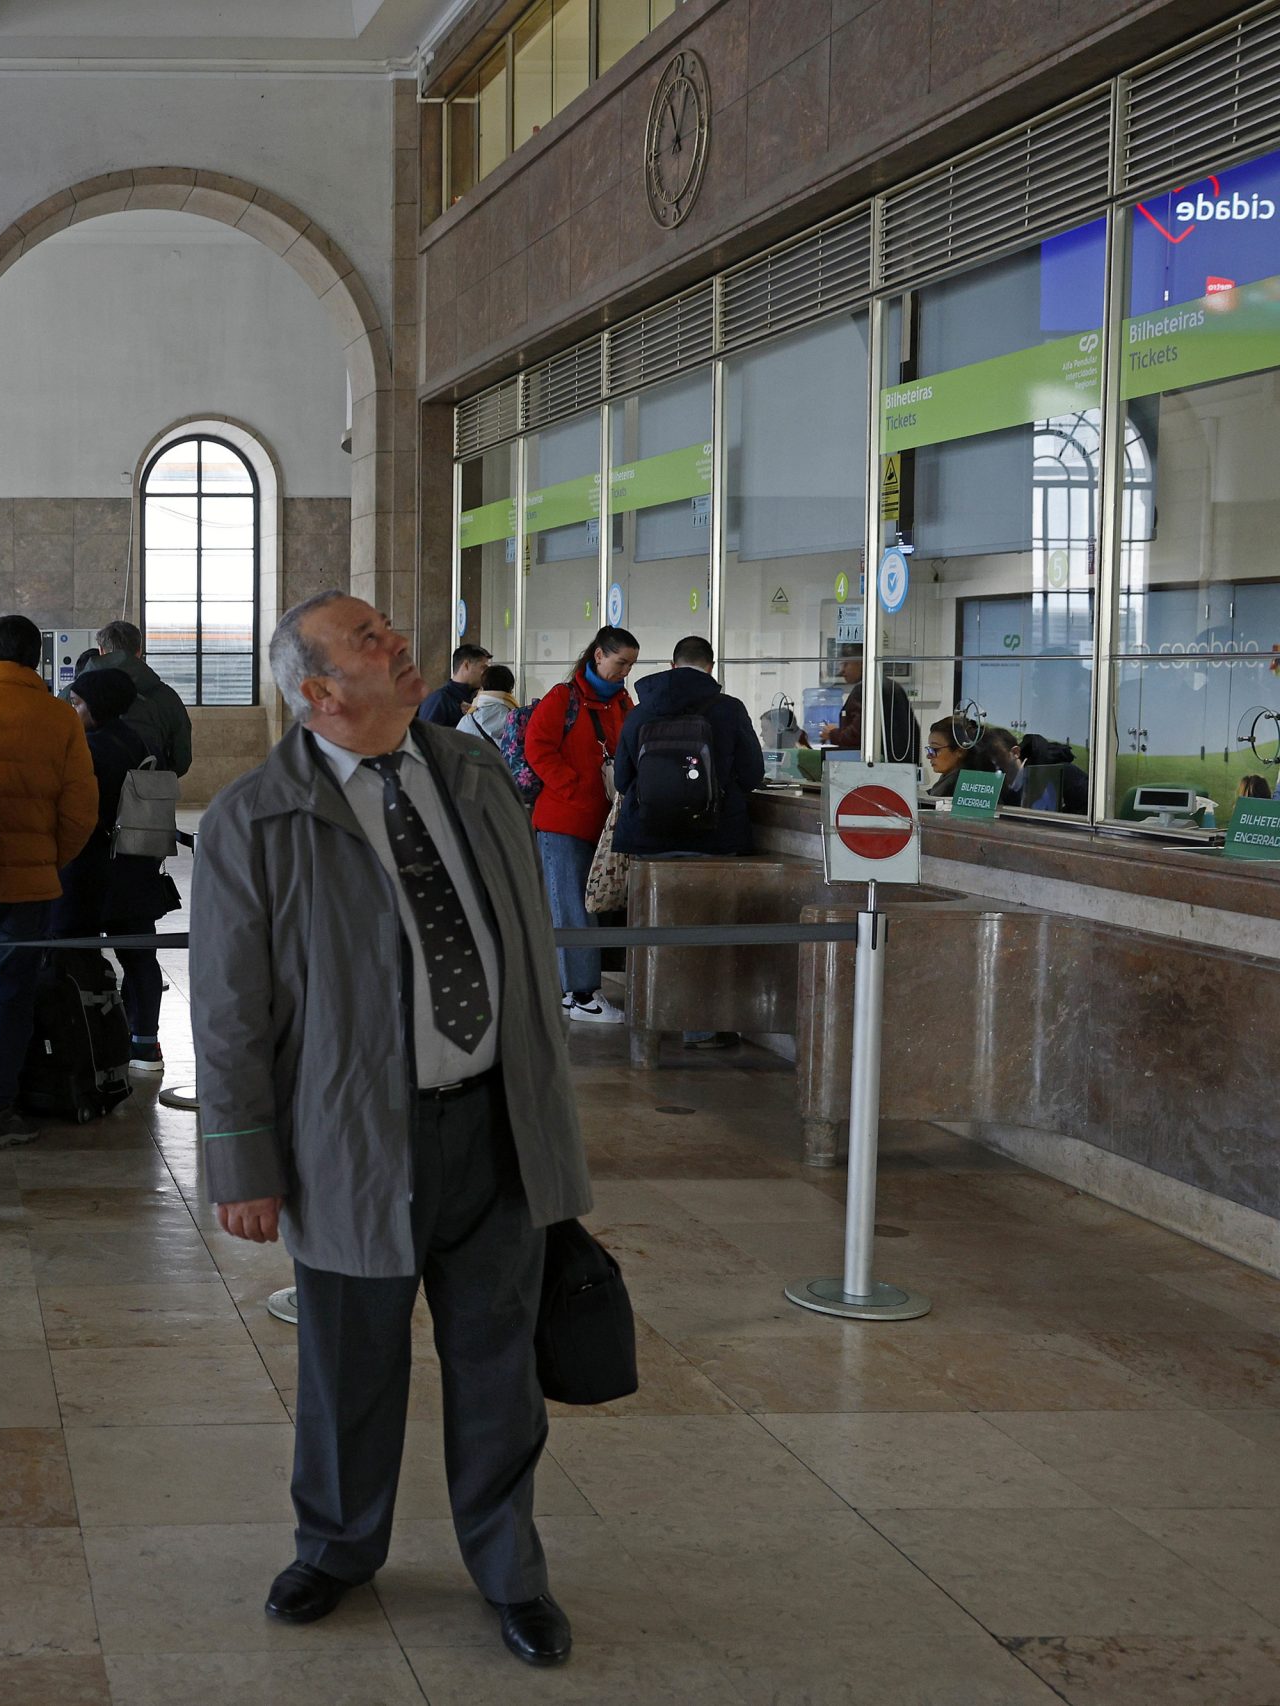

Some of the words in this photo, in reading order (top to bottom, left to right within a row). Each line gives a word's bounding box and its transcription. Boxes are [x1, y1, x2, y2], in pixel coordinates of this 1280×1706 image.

[1129, 310, 1205, 344] Bilheteiras
[1129, 344, 1178, 371] Tickets
[886, 386, 933, 409] Bilheteiras
[886, 413, 917, 431] Tickets
[1052, 554, 1062, 580] 5
[837, 577, 845, 598] 4
[585, 601, 590, 617] 2
[691, 592, 698, 610] 3
[960, 782, 995, 795] BILHETEIRA
[956, 796, 991, 809] ENCERRADA
[1239, 813, 1280, 828] BILHETEI
